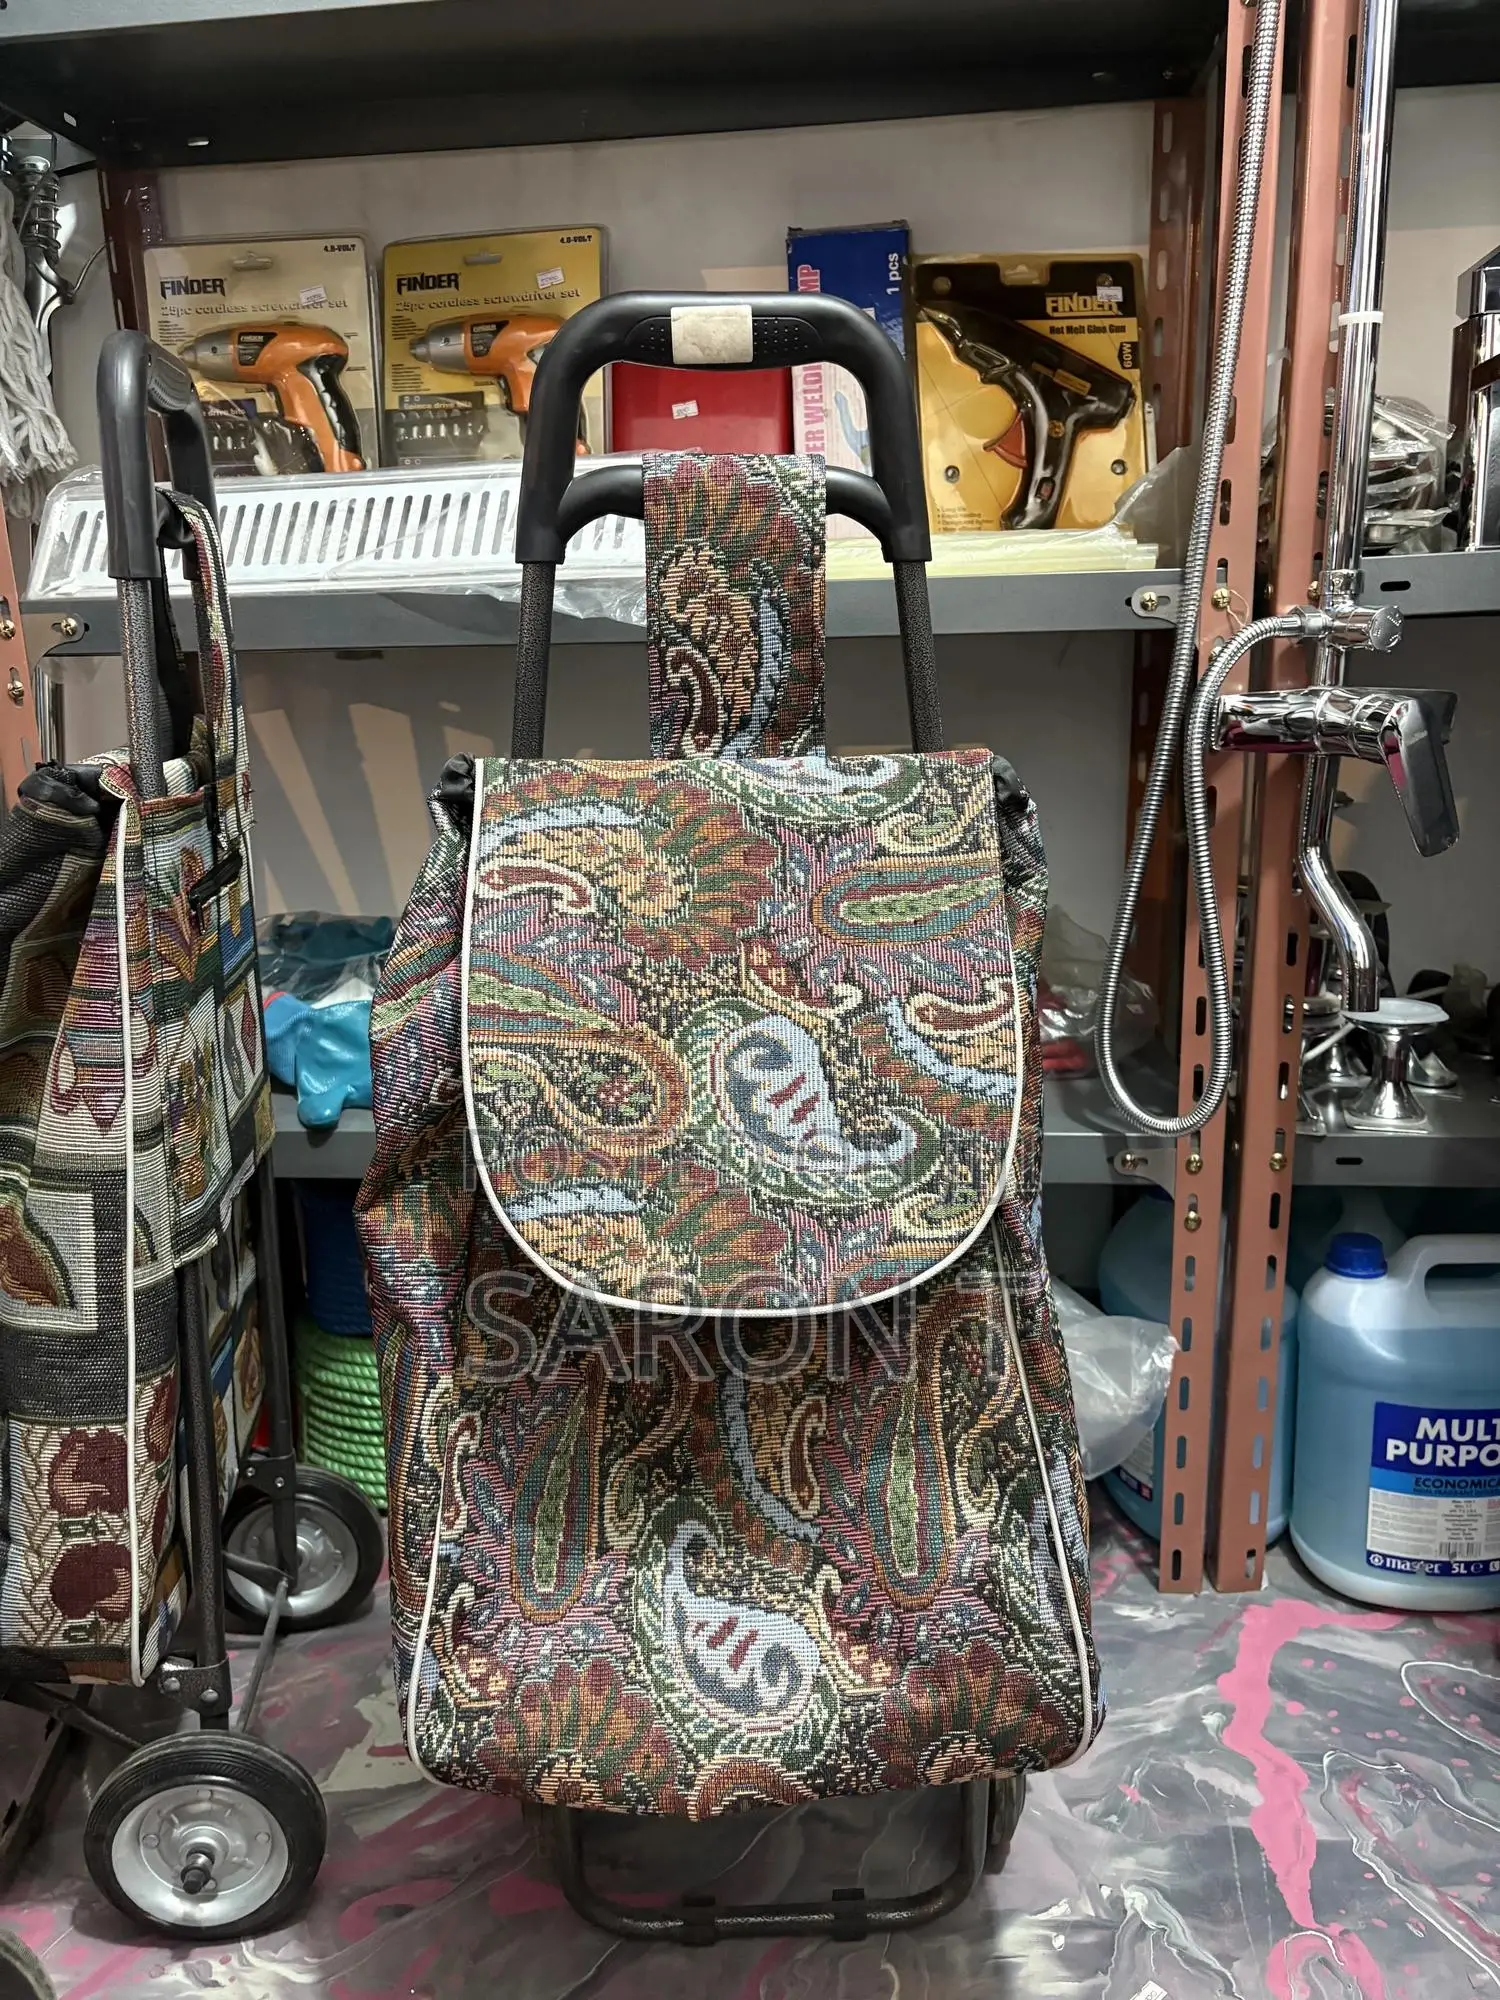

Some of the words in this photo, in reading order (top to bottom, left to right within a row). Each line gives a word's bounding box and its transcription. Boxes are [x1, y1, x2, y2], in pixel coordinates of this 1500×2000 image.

[888, 253, 902, 282] pcs
[160, 276, 226, 299] FINDER
[397, 272, 460, 295] FINDER
[887, 287, 899, 295] 1
[195, 303, 248, 315] cordless
[328, 299, 348, 309] set
[429, 297, 480, 309] cordless
[484, 291, 556, 305] screwdriver
[560, 288, 580, 298] set
[1046, 292, 1123, 317] FINDER
[1050, 325, 1064, 334] Hot
[1066, 325, 1086, 335] Melt
[1087, 324, 1107, 335] Glue
[1109, 324, 1126, 334] Gun
[1123, 343, 1133, 368] 60W
[1386, 1438, 1500, 1468] PURPO
[1451, 1562, 1467, 1574] 5L
